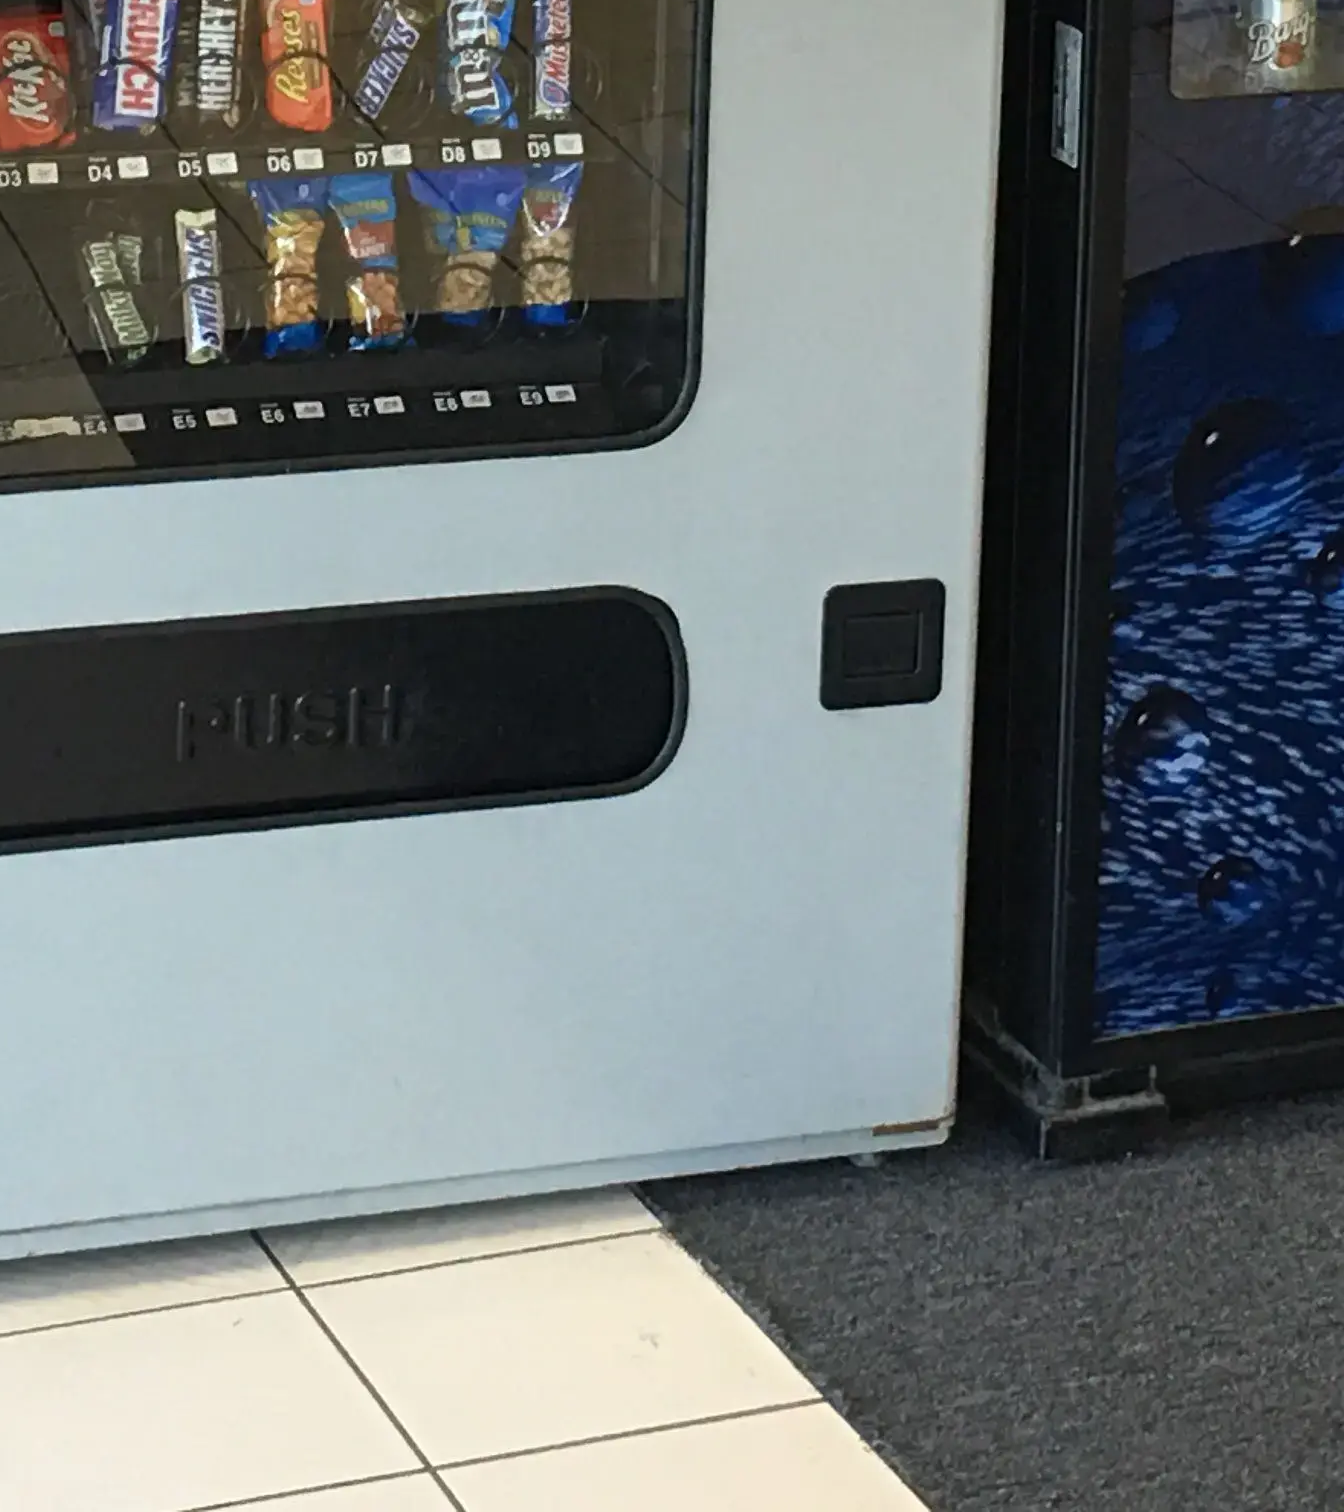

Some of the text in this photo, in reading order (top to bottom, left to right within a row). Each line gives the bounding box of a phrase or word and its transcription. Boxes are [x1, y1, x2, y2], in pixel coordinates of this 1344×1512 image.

[441, 145, 466, 164] D8
[527, 140, 552, 159] D9
[266, 154, 291, 172] D6
[355, 150, 378, 168] D7
[88, 165, 113, 183] D4
[178, 160, 202, 178] D5
[260, 408, 285, 424] E6
[347, 403, 370, 419] E7
[83, 419, 108, 436] E4
[173, 414, 197, 431] E5
[176, 684, 394, 763] PUSH
